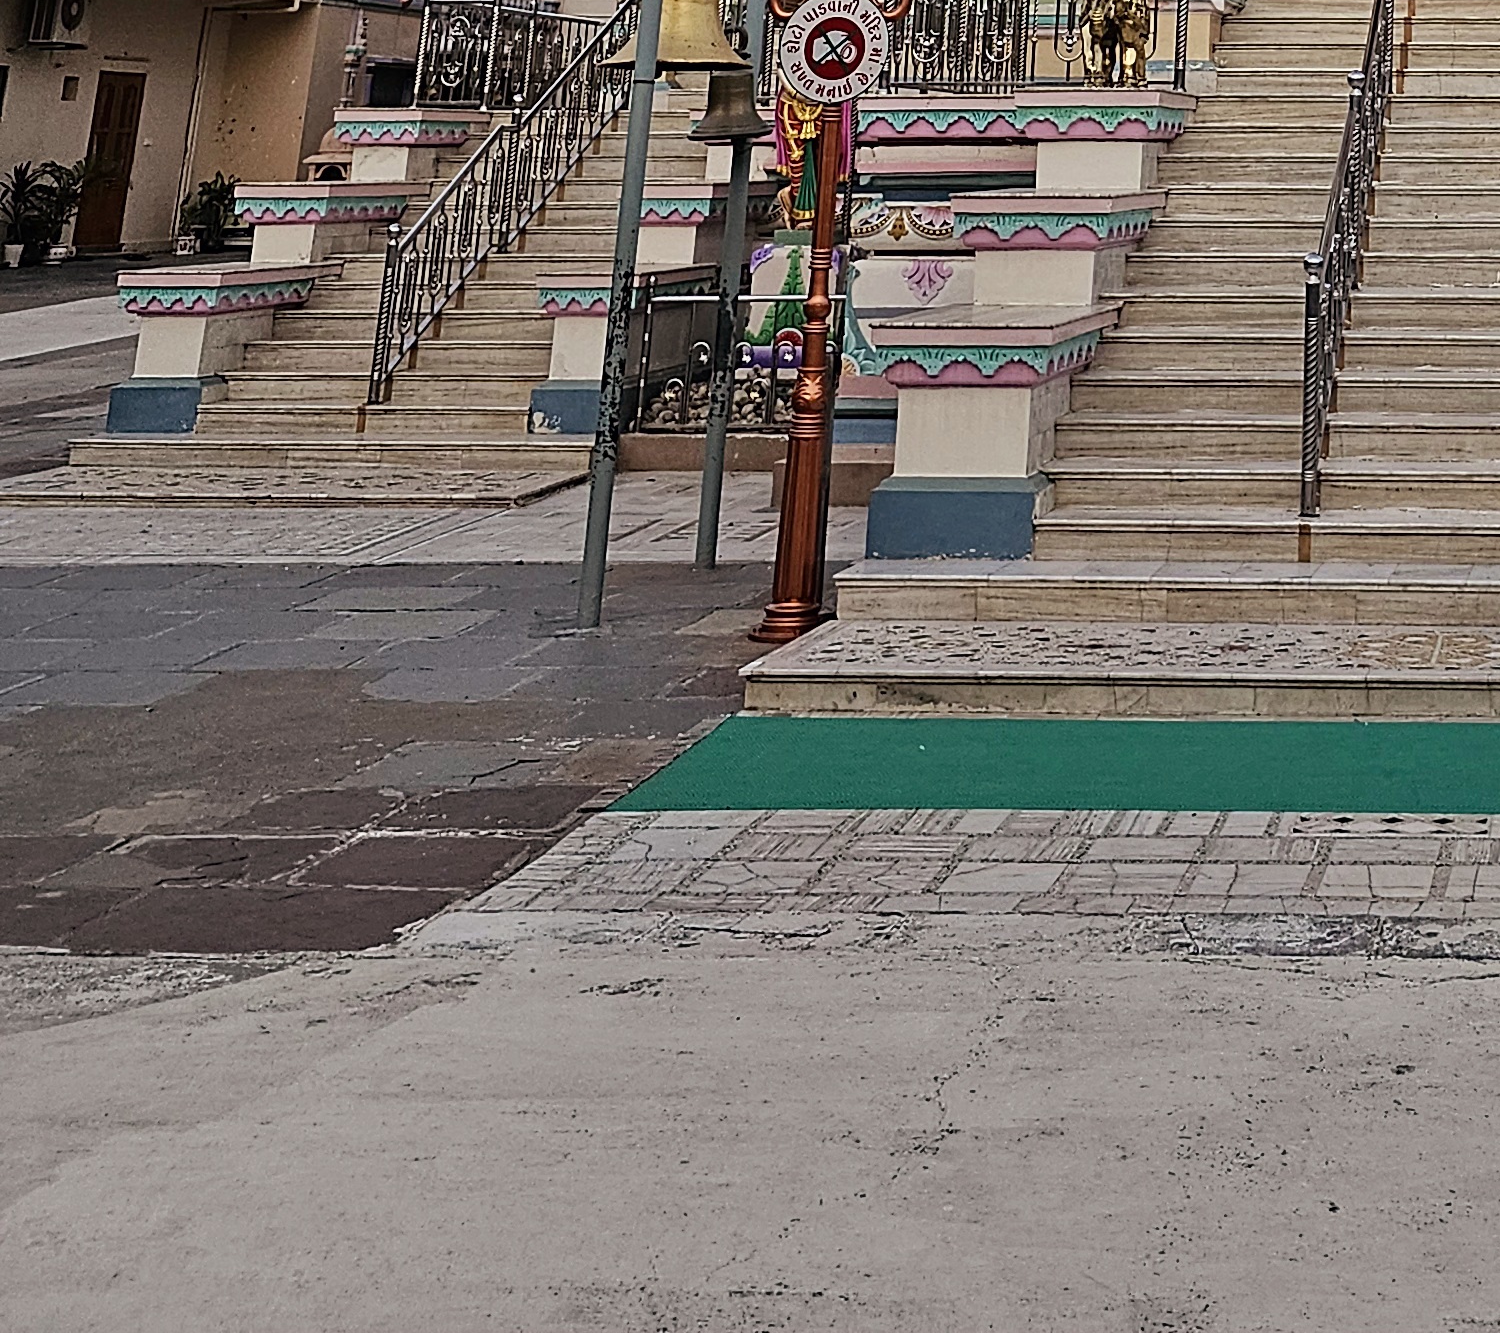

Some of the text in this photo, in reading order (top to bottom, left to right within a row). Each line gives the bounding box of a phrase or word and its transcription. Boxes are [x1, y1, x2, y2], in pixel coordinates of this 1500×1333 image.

[803, 0, 859, 23] પાડવાની
[859, 10, 882, 42] મંદિર
[815, 78, 852, 98] મનાઈ
